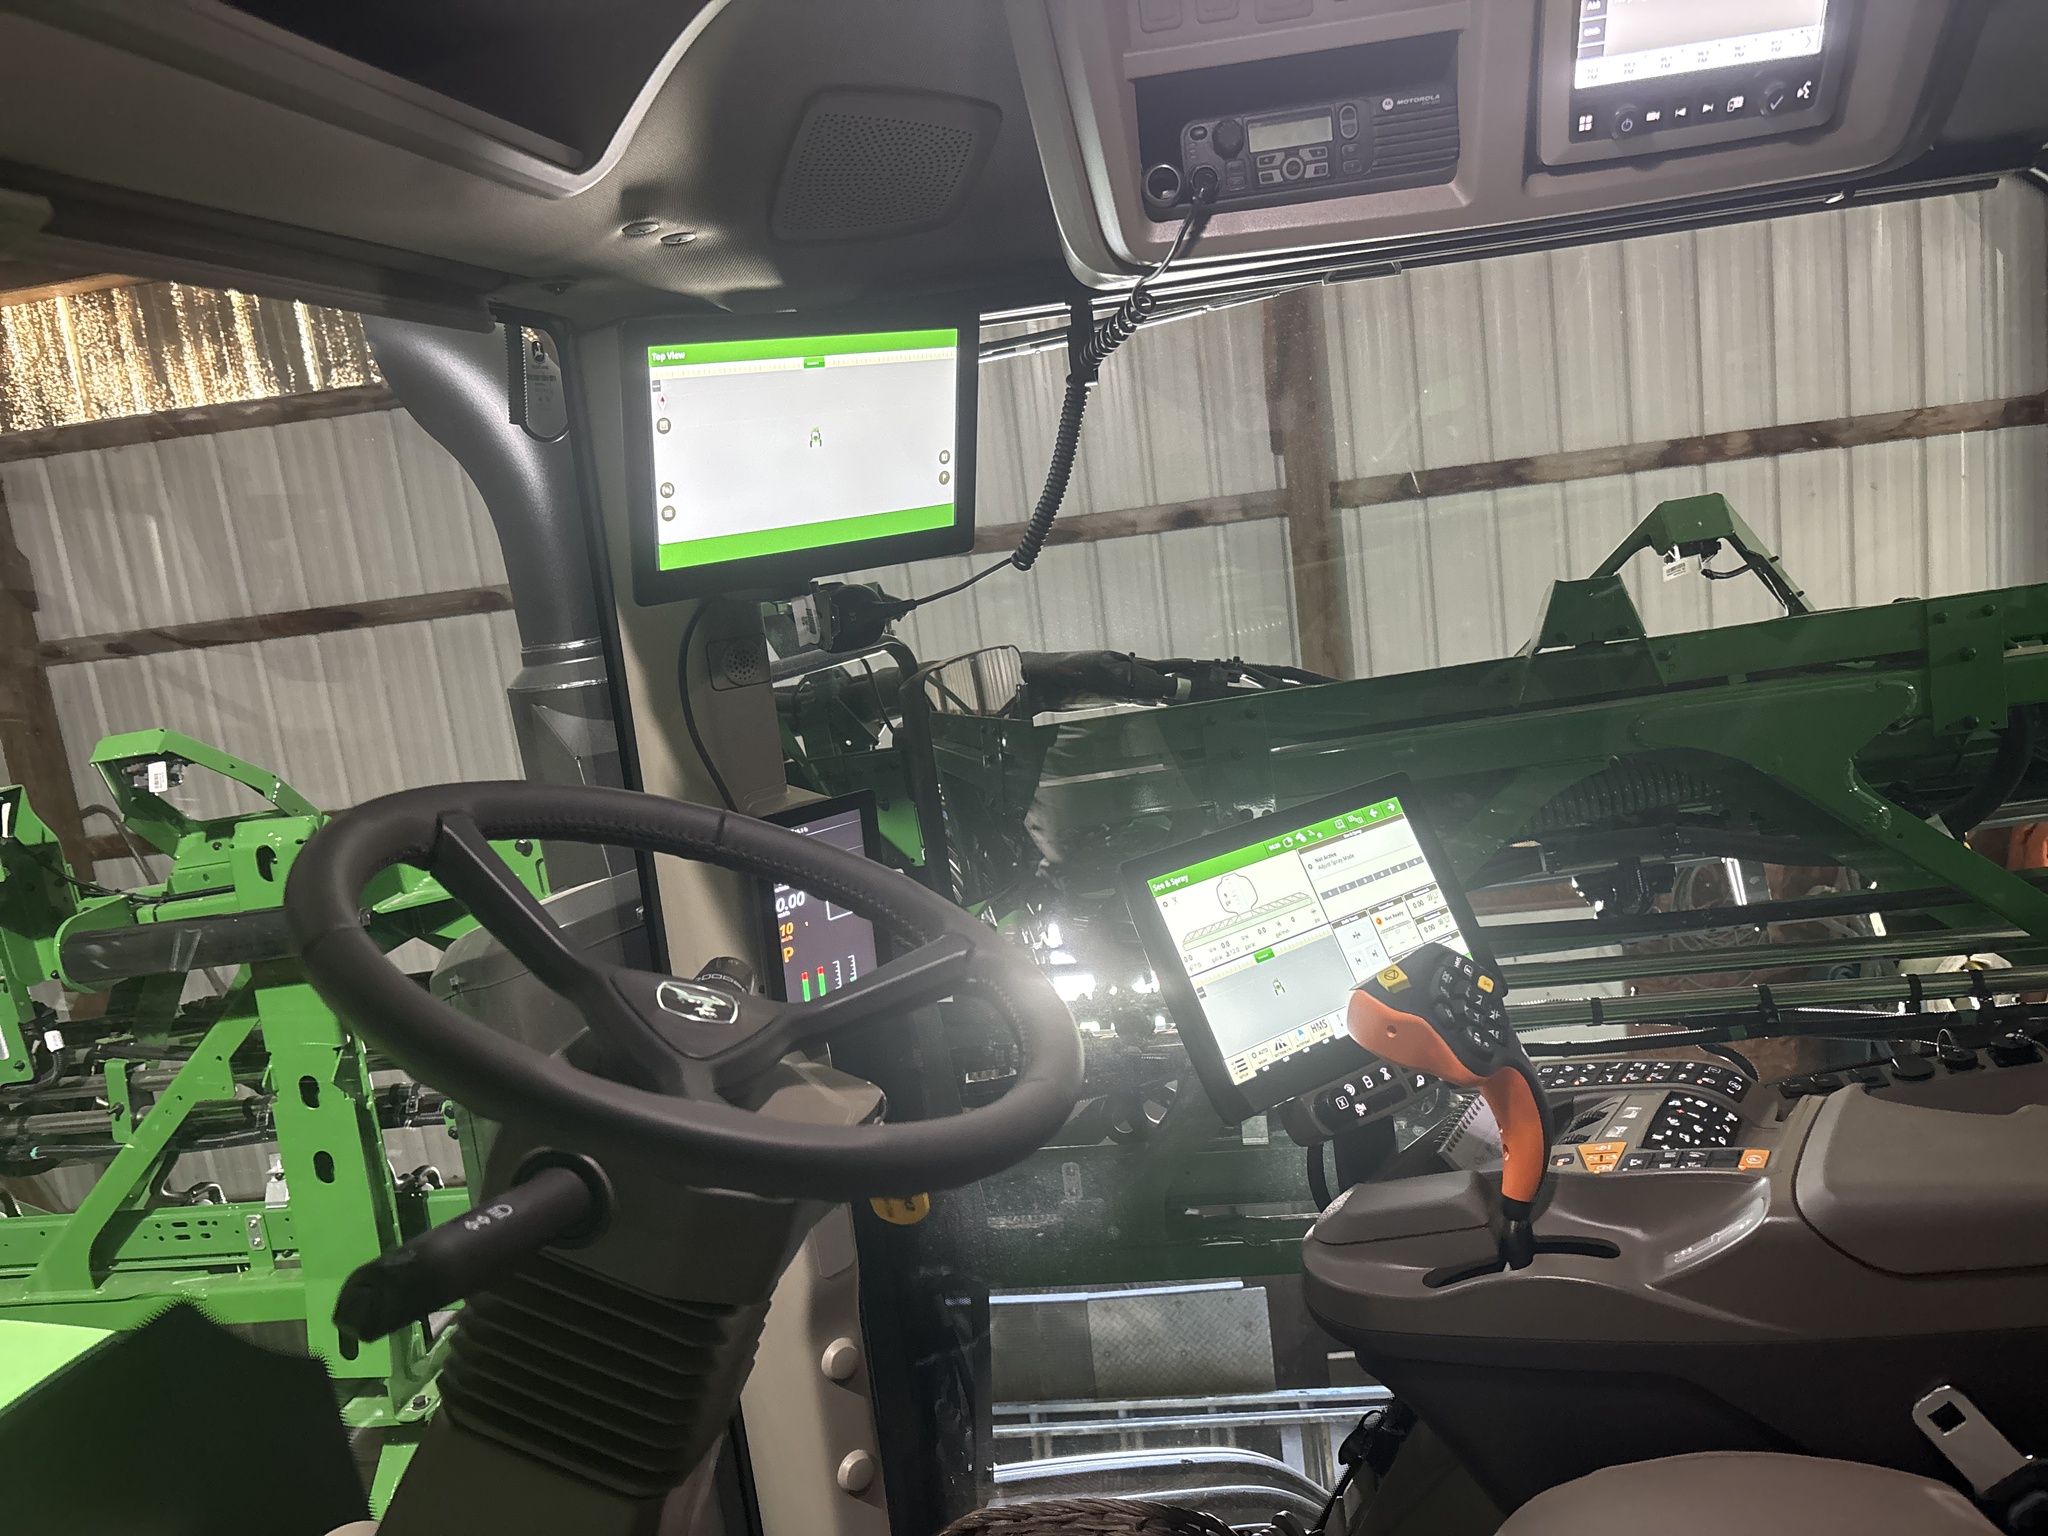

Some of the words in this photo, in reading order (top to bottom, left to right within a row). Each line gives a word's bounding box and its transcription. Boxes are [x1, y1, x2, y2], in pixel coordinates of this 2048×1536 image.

[1396, 94, 1440, 106] MOTOROLA
[651, 352, 666, 363] Top
[666, 351, 686, 361] View
[1318, 861, 1331, 870] Adjust
[1331, 857, 1343, 867] Spray
[1343, 853, 1355, 861] Mode
[1323, 852, 1337, 861] Active
[1152, 883, 1165, 892] See
[1170, 874, 1189, 886] Spray
[775, 891, 805, 913] 0.00
[1412, 900, 1424, 909] 0.00
[1392, 911, 1404, 919] Ready
[779, 922, 794, 937] 10
[1257, 927, 1267, 935] 0.0
[1423, 924, 1436, 933] 0.00
[1221, 940, 1231, 949] 0.0
[783, 946, 794, 963] P
[1183, 954, 1194, 963] 0.0
[1310, 1019, 1328, 1033] HMS
[1258, 1047, 1269, 1056] AUTO
